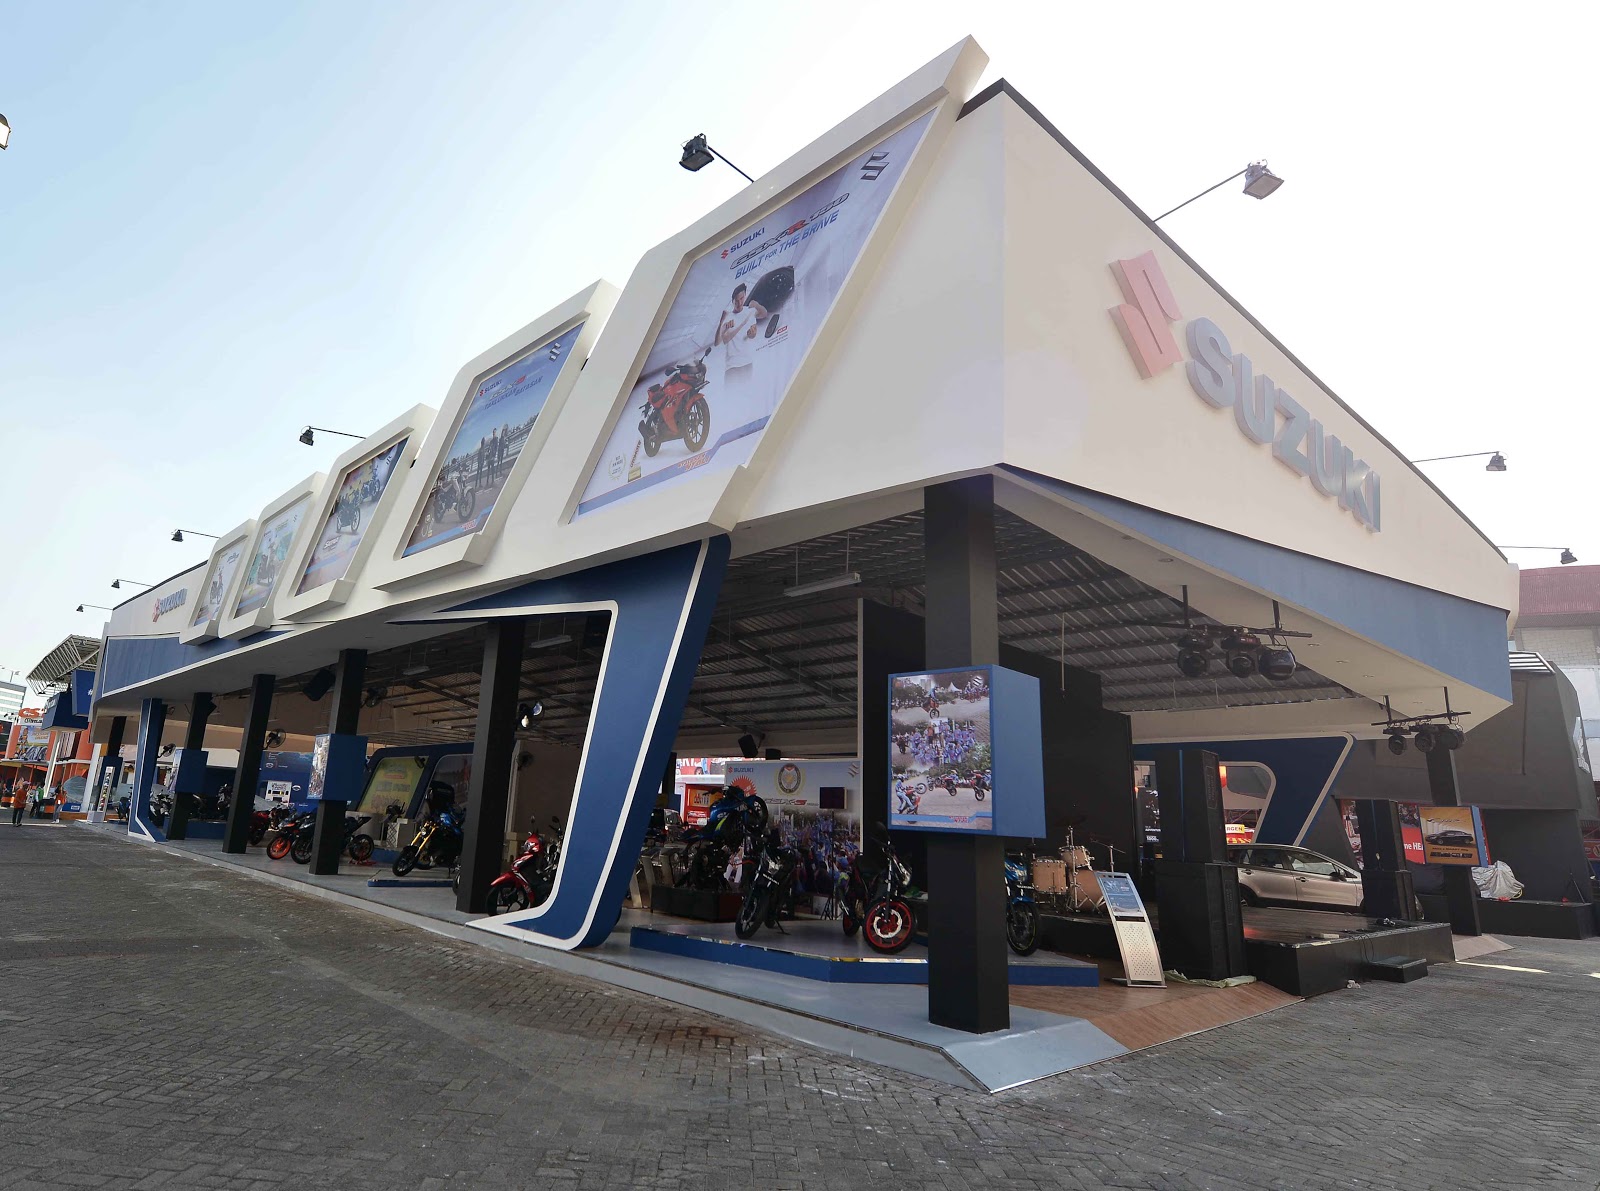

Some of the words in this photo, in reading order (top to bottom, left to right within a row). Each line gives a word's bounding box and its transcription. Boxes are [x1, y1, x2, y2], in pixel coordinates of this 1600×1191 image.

[730, 227, 765, 253] SUZUKI
[735, 253, 765, 279] BUILT
[764, 248, 777, 261] FOR
[779, 233, 801, 253] THE
[801, 209, 840, 240] BRAVE
[484, 379, 502, 394] SUZUKI
[1185, 316, 1381, 533] SUZUKI
[159, 588, 187, 616] SUZUKI
